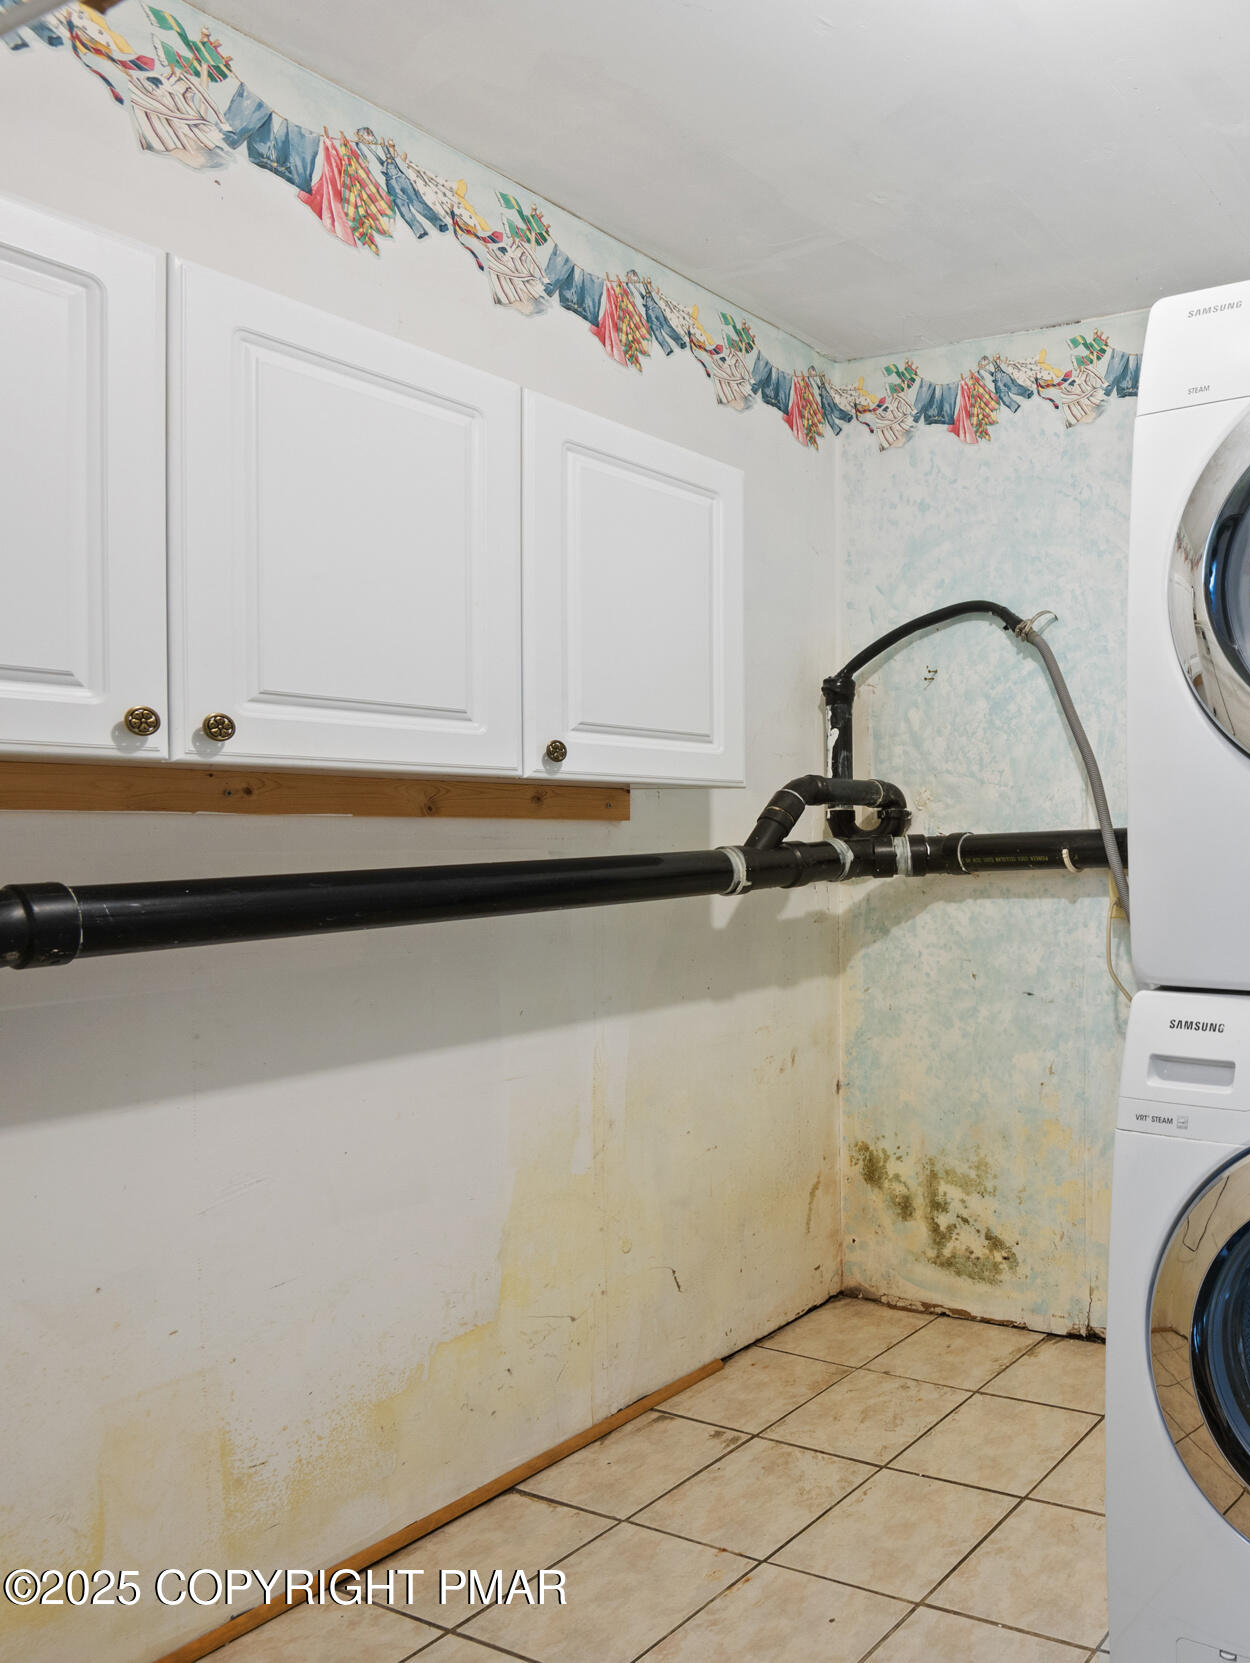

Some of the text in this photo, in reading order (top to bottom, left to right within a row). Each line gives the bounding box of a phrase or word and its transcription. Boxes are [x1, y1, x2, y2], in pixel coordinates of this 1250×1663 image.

[1188, 300, 1243, 318] SAMSUNG
[1188, 385, 1210, 395] STEAM
[1169, 1019, 1225, 1033] SAMSUNG
[1151, 1115, 1174, 1125] STEAM
